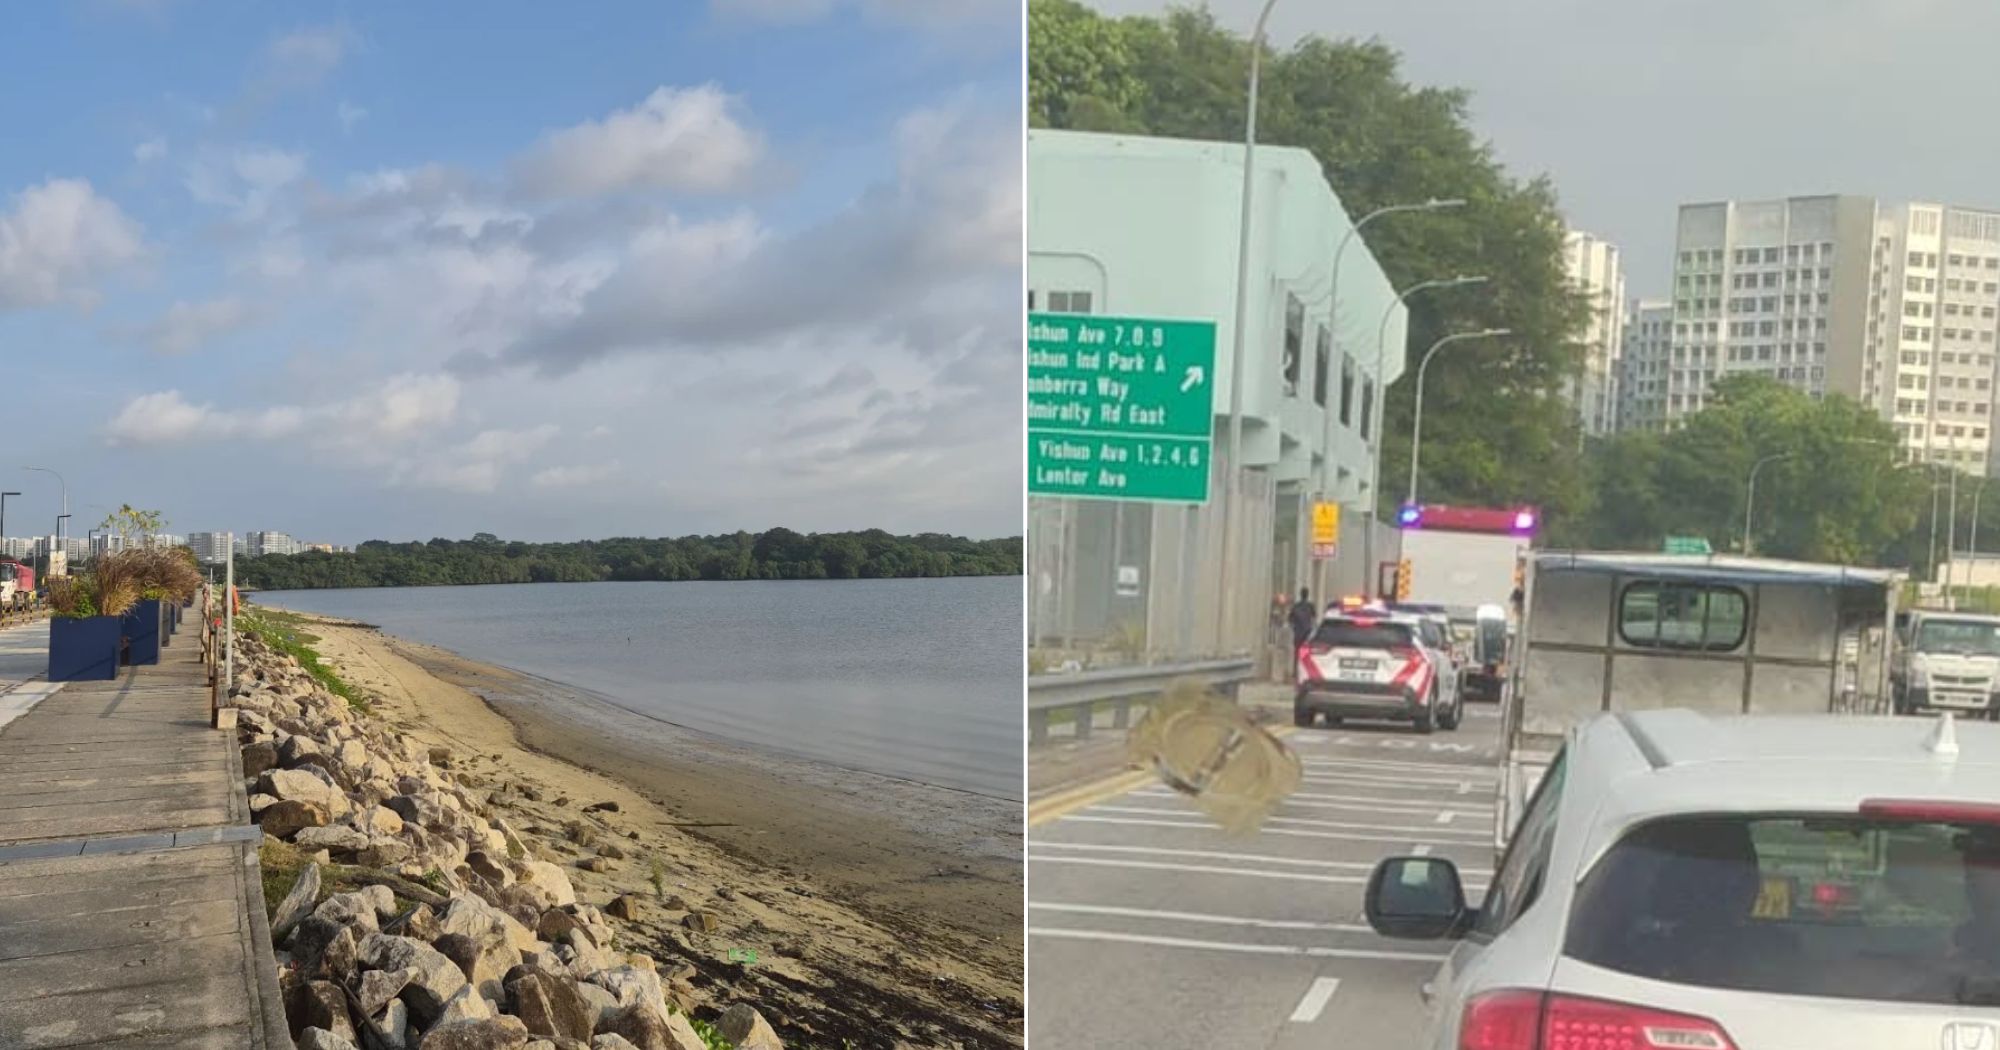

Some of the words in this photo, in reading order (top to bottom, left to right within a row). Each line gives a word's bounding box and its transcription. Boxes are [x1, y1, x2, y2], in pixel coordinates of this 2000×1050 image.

[1028, 321, 1069, 342] ishun
[1077, 323, 1106, 344] Ave
[1028, 347, 1068, 368] ishun
[1076, 349, 1100, 370] Ind
[1109, 351, 1145, 372] Park
[1154, 353, 1166, 373] A
[1028, 374, 1088, 396] anberra
[1097, 376, 1129, 403] Way
[1028, 400, 1091, 425] dmiralty
[1101, 403, 1121, 425] Rd
[1130, 405, 1166, 426] East
[1039, 440, 1091, 460] Yishun
[1100, 443, 1128, 463] Ave
[1036, 464, 1089, 485] Lentor
[1098, 467, 1127, 487] Ave
